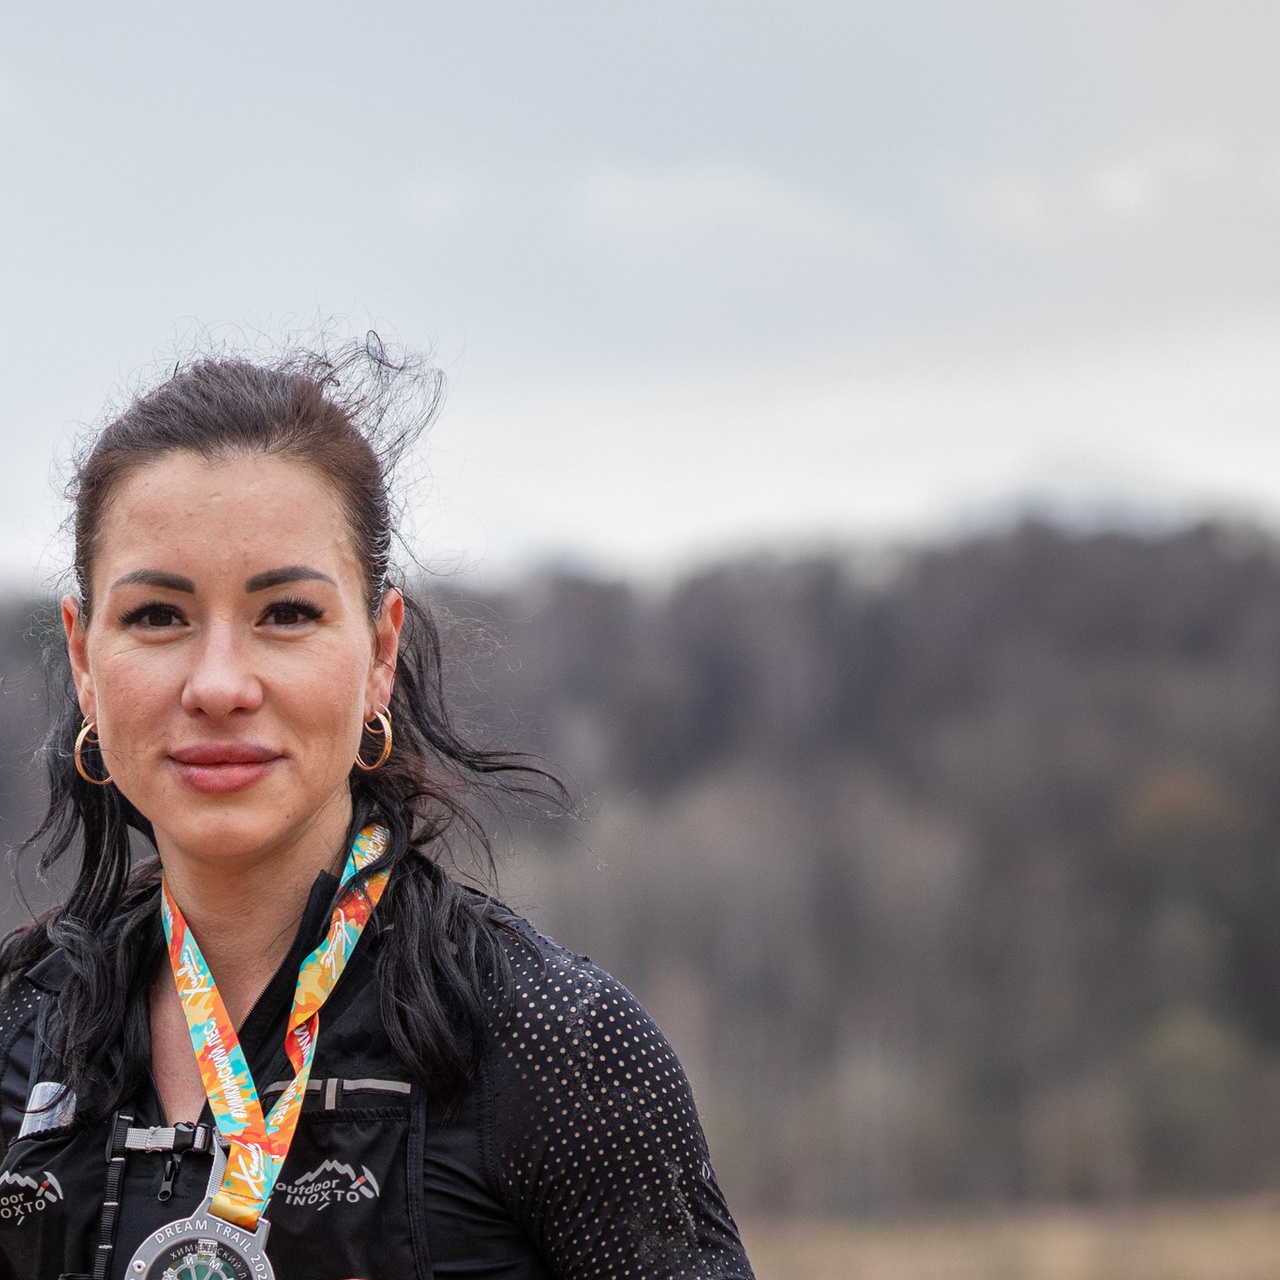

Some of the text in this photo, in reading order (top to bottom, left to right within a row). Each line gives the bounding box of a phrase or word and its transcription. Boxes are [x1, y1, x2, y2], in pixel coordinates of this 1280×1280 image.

[203, 1021, 222, 1047] ЛЕС
[275, 1179, 340, 1195] outdoor
[285, 1190, 360, 1211] INOXTO
[154, 1219, 208, 1244] DREAM
[215, 1222, 252, 1253] TRAIL
